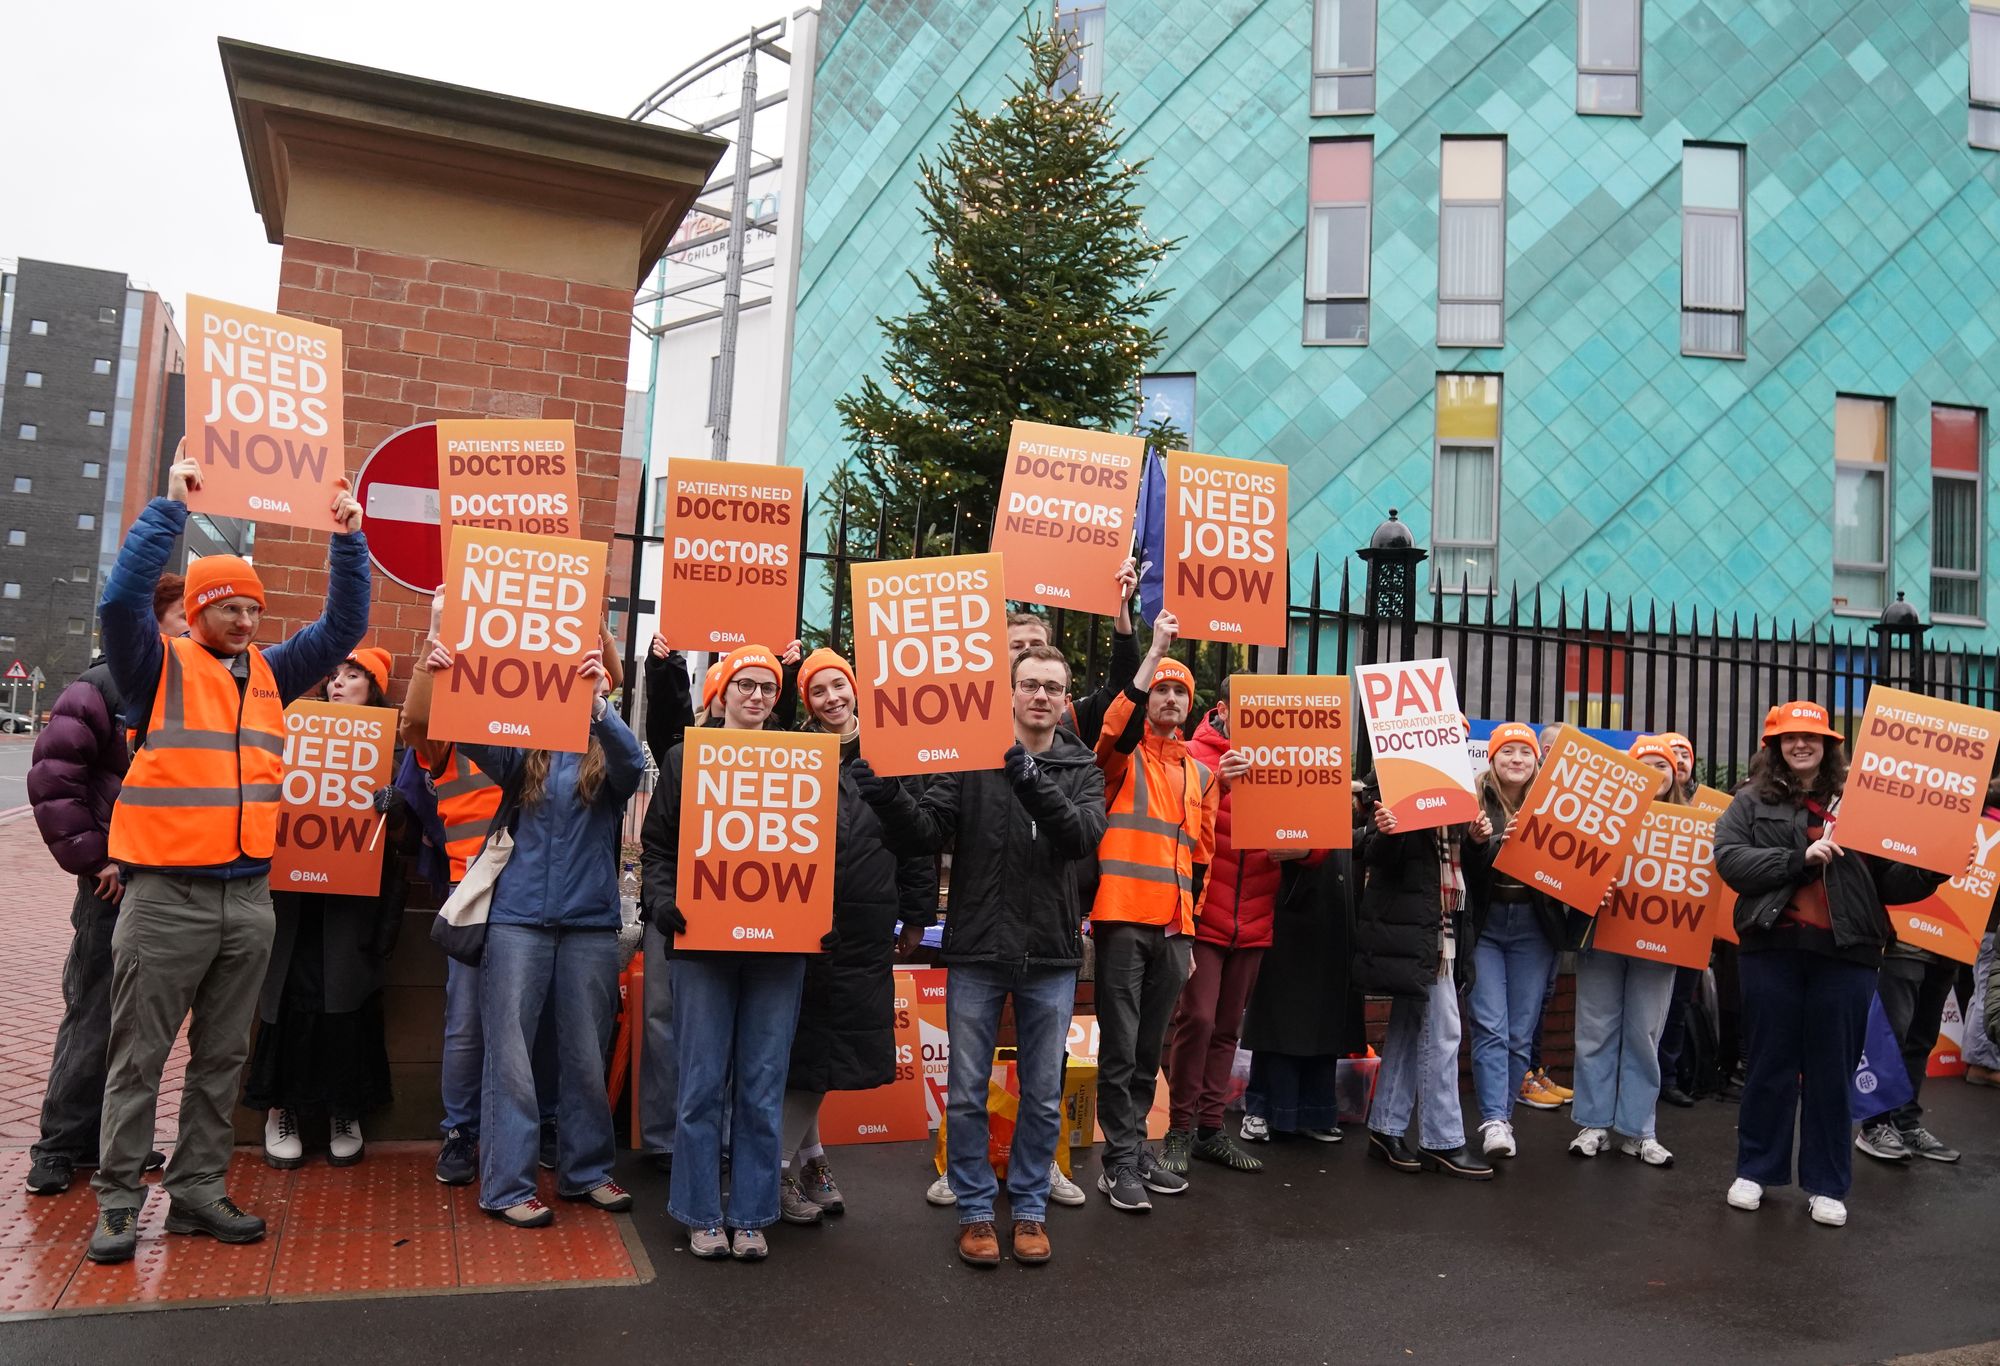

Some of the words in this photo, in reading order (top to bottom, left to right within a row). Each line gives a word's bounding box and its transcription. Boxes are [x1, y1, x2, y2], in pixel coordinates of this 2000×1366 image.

[204, 313, 327, 360] DOCTORS
[203, 337, 327, 394] NEED
[204, 378, 328, 436] JOBS
[205, 425, 328, 483] NOW
[448, 440, 520, 452] PATIENTS
[523, 441, 565, 452] NEED
[1018, 441, 1088, 462] PATIENTS
[1090, 452, 1131, 468] NEED
[449, 454, 566, 476] DOCTORS
[1015, 455, 1129, 490] DOCTORS
[1180, 465, 1276, 494] DOCTORS
[450, 493, 568, 517] DOCTORS
[677, 481, 747, 498] PATIENTS
[752, 487, 792, 501] NEED
[263, 499, 291, 513] BMA
[676, 496, 791, 526] DOCTORS
[1008, 491, 1123, 529] DOCTORS
[1179, 486, 1275, 526] NEED
[1005, 515, 1064, 538] NEED
[1066, 525, 1120, 548] JOBS
[1178, 520, 1275, 564] JOBS
[465, 543, 590, 576] DOCTORS
[674, 537, 789, 566] DOCTORS
[673, 562, 732, 583] NEED
[736, 566, 788, 587] JOBS
[867, 569, 988, 598] DOCTORS
[1177, 561, 1274, 605] NOW
[207, 585, 235, 599] BMA
[461, 567, 587, 613] NEED
[1046, 585, 1071, 598] BMA
[868, 594, 990, 636] NEED
[1220, 622, 1242, 633] BMA
[456, 606, 583, 656] JOBS
[721, 632, 746, 643] BMA
[743, 655, 768, 664] BMA
[873, 632, 994, 687] JOBS
[1165, 669, 1185, 679] BMA
[450, 652, 578, 704] NOW
[1362, 666, 1445, 719] PAY
[874, 680, 995, 729] NOW
[1240, 695, 1302, 707] PATIENTS
[1305, 695, 1341, 707] NEED
[1802, 708, 1821, 720] BMA
[502, 723, 531, 736] BMA
[1240, 709, 1342, 729] DOCTORS
[1372, 716, 1437, 732] RESTORATION
[1438, 713, 1457, 725] FOR
[1875, 705, 1945, 730] PATIENTS
[1947, 721, 1990, 741] NEED
[1375, 726, 1461, 754] DOCTORS
[1870, 717, 1986, 761] DOCTORS
[699, 744, 823, 770] DOCTORS
[931, 748, 959, 761] BMA
[1240, 746, 1342, 767] DOCTORS
[1564, 740, 1649, 793] DOCTORS
[1240, 769, 1293, 785] NEED
[1297, 769, 1342, 788] JOBS
[1550, 757, 1638, 816] NEED
[1861, 751, 1977, 796] DOCTORS
[282, 770, 376, 811] OBS
[697, 769, 821, 809] NEED
[1426, 796, 1447, 809] BMA
[1857, 772, 1915, 800] NEED
[1917, 787, 1972, 814] JOBS
[1534, 785, 1627, 847] JOBS
[1642, 811, 1716, 838] OCTORS
[695, 810, 820, 857] JOBS
[1286, 830, 1308, 839] BMA
[1519, 815, 1612, 877] NOW
[1892, 841, 1918, 856] BMA
[303, 872, 328, 883] BMA
[692, 860, 818, 904] NOW
[1542, 874, 1563, 890] BMA
[1616, 855, 1712, 897] JOBS
[1611, 888, 1706, 932] NOW
[746, 928, 774, 939] BMA
[1919, 920, 1944, 937] BMA
[1645, 941, 1668, 954] BMA
[894, 998, 909, 1008] ED
[867, 1124, 888, 1134] BMA
